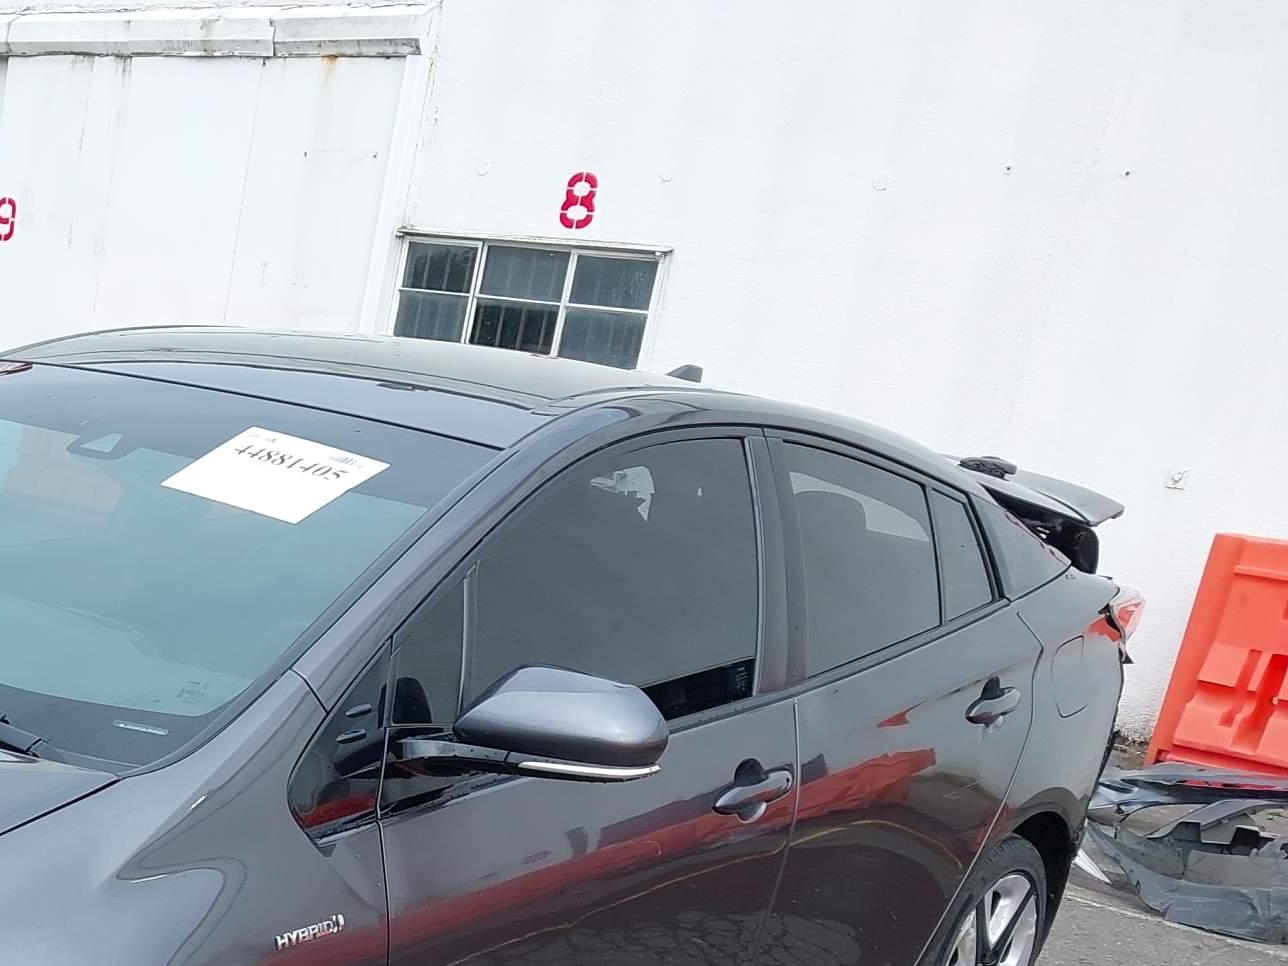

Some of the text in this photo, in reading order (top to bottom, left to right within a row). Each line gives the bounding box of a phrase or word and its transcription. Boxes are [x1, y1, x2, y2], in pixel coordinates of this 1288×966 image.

[559, 171, 598, 230] 8
[233, 443, 349, 481] 44881405
[274, 919, 335, 951] HYBRID
